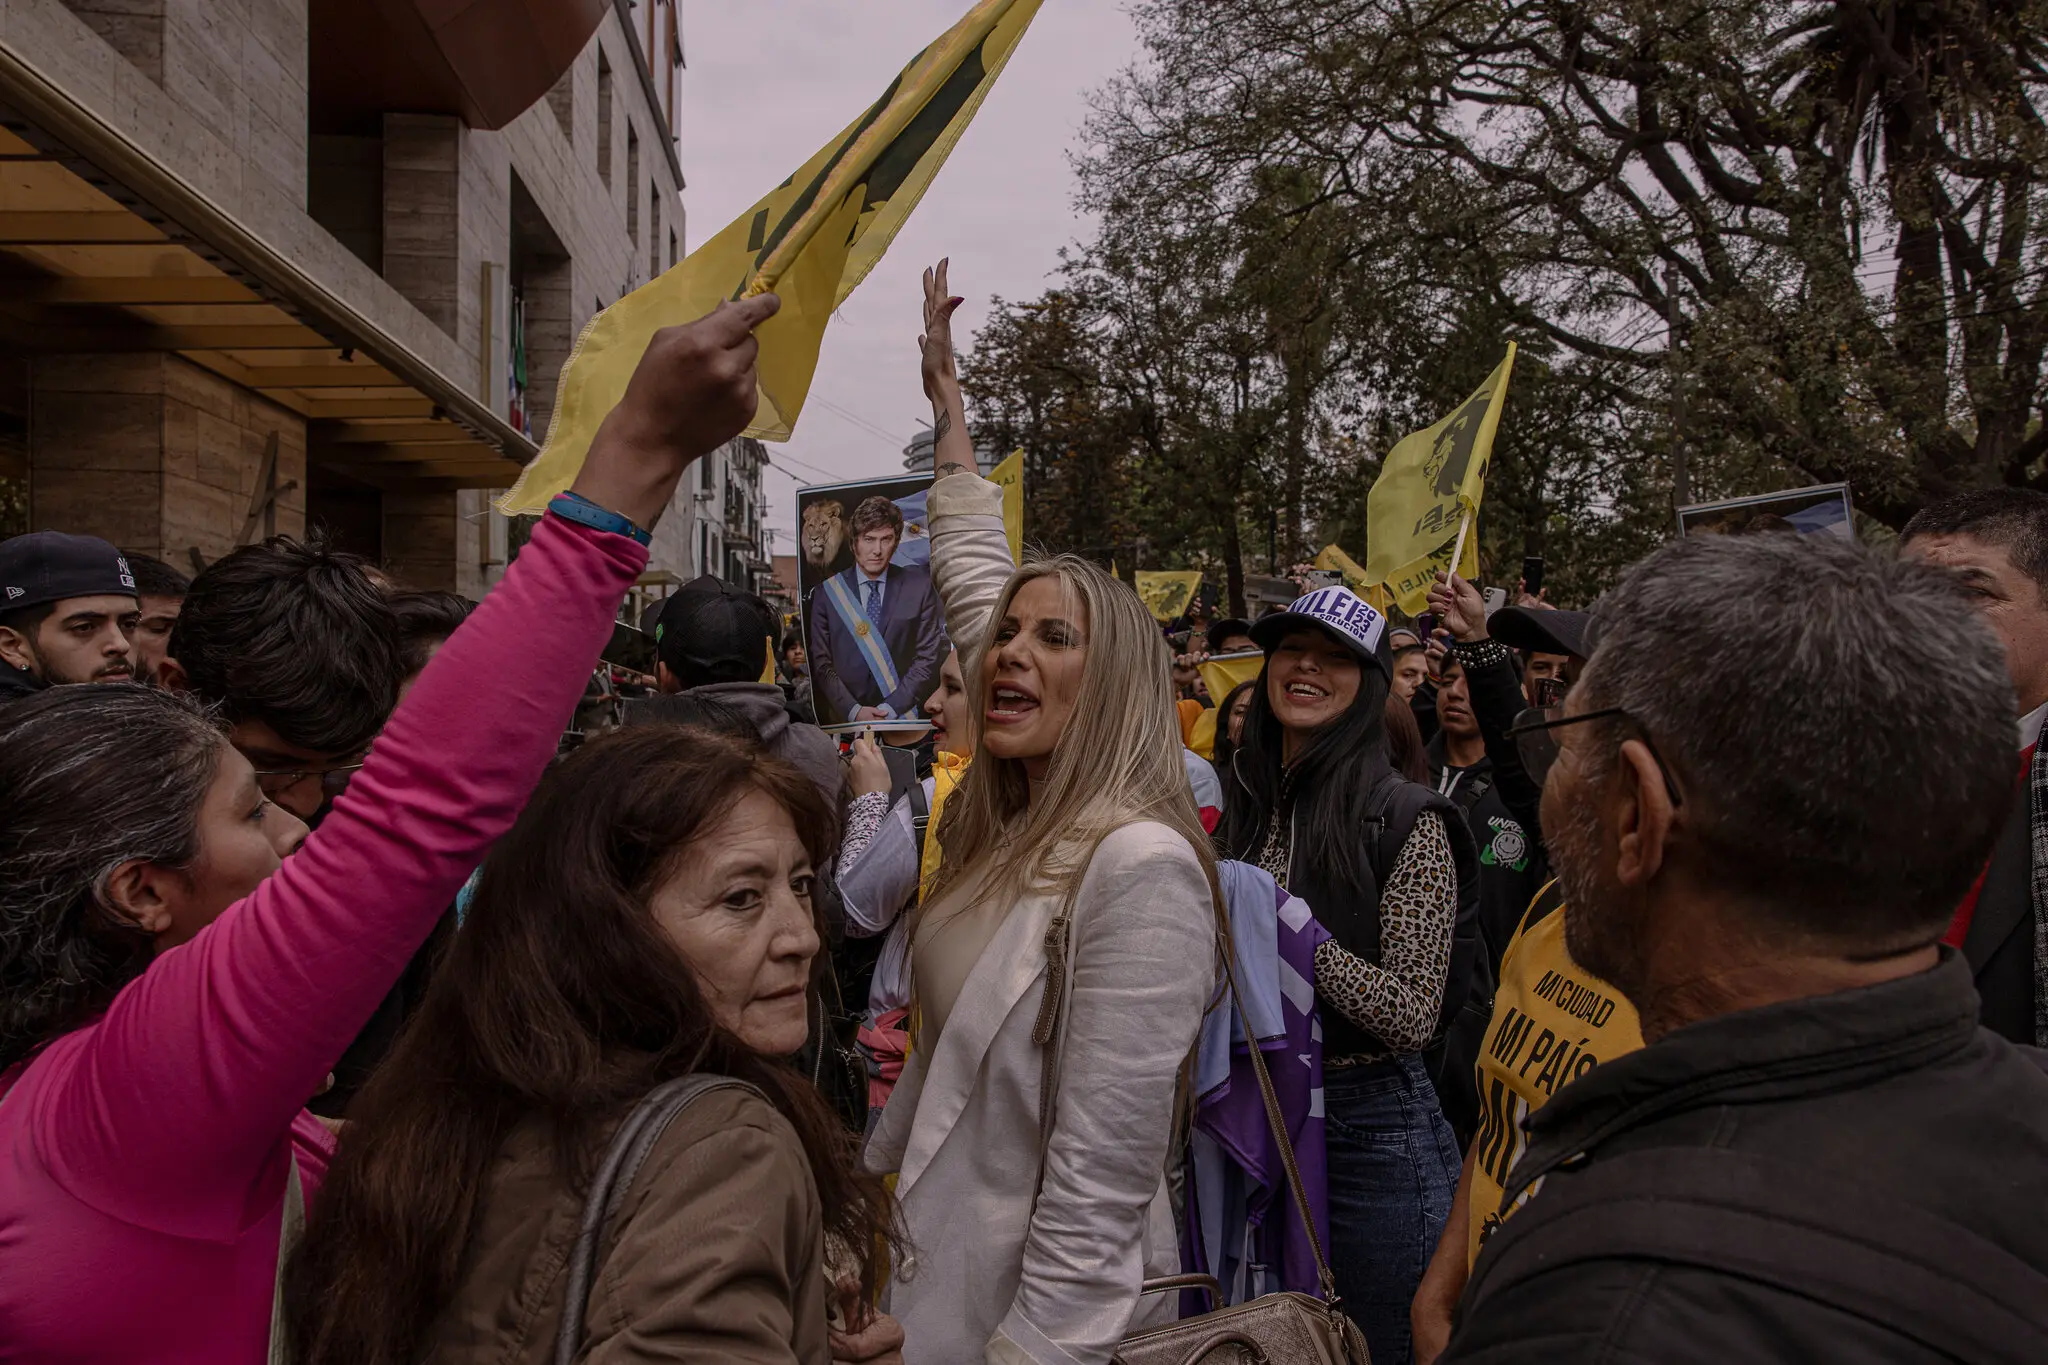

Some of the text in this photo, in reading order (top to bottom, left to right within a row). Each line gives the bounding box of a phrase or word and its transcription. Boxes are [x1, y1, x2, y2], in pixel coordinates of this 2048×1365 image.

[1290, 590, 1361, 622] MILEI
[1319, 613, 1365, 641] SOLUCIÓN
[1532, 969, 1615, 1029] MI CIUDAD
[1489, 1006, 1536, 1069] MI
